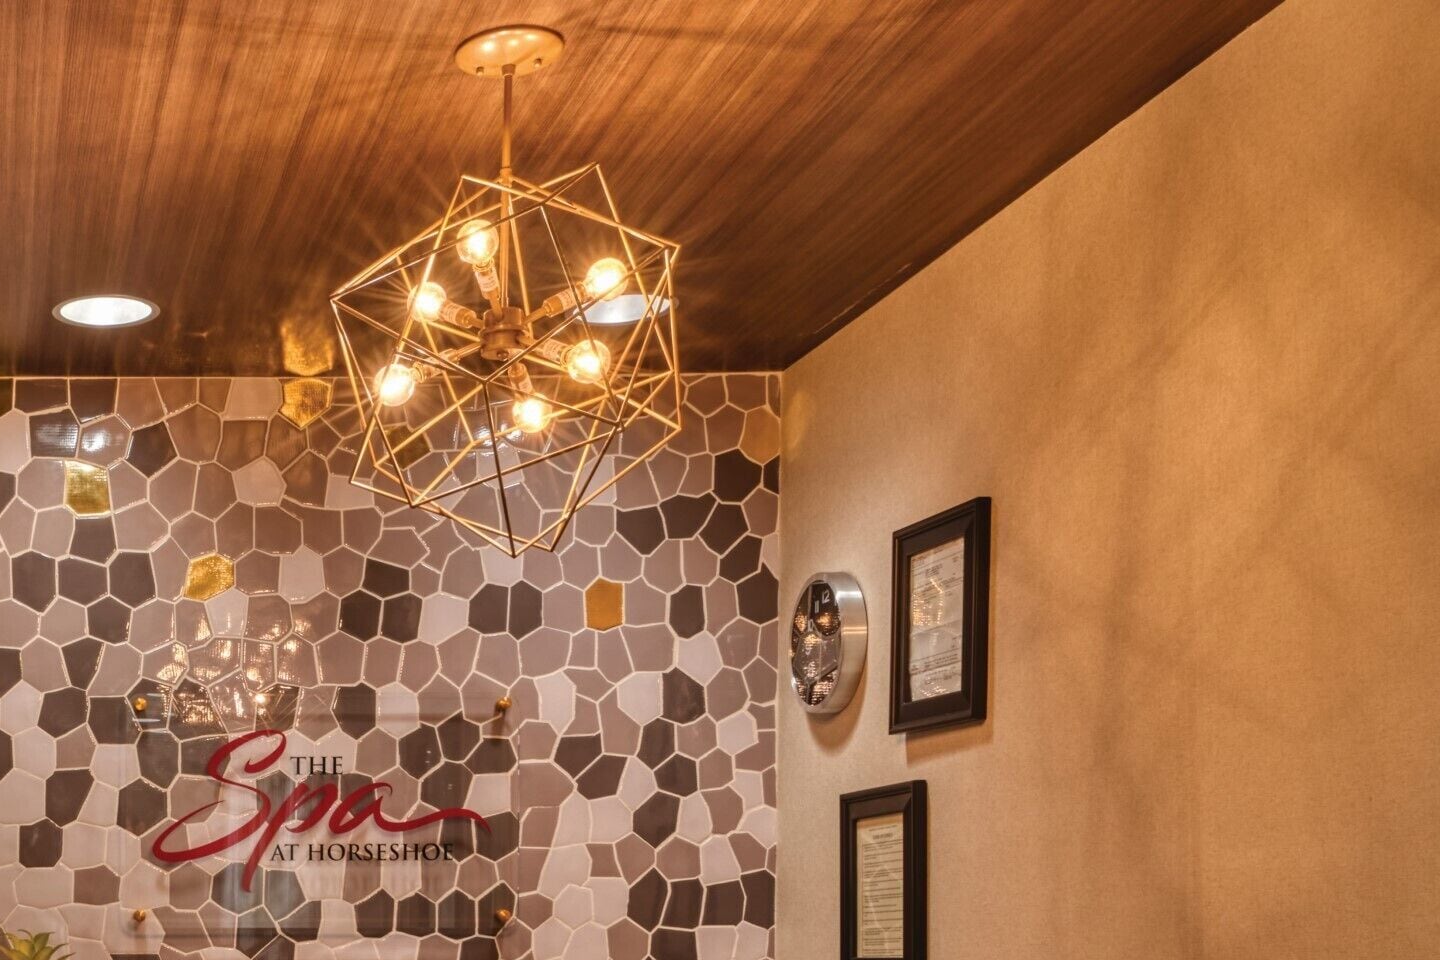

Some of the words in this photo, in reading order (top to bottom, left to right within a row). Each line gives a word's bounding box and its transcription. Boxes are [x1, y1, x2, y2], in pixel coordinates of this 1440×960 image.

[290, 756, 343, 775] THE
[152, 729, 492, 893] Spa
[271, 843, 300, 861] AT
[308, 843, 455, 861] HORSESHOE
